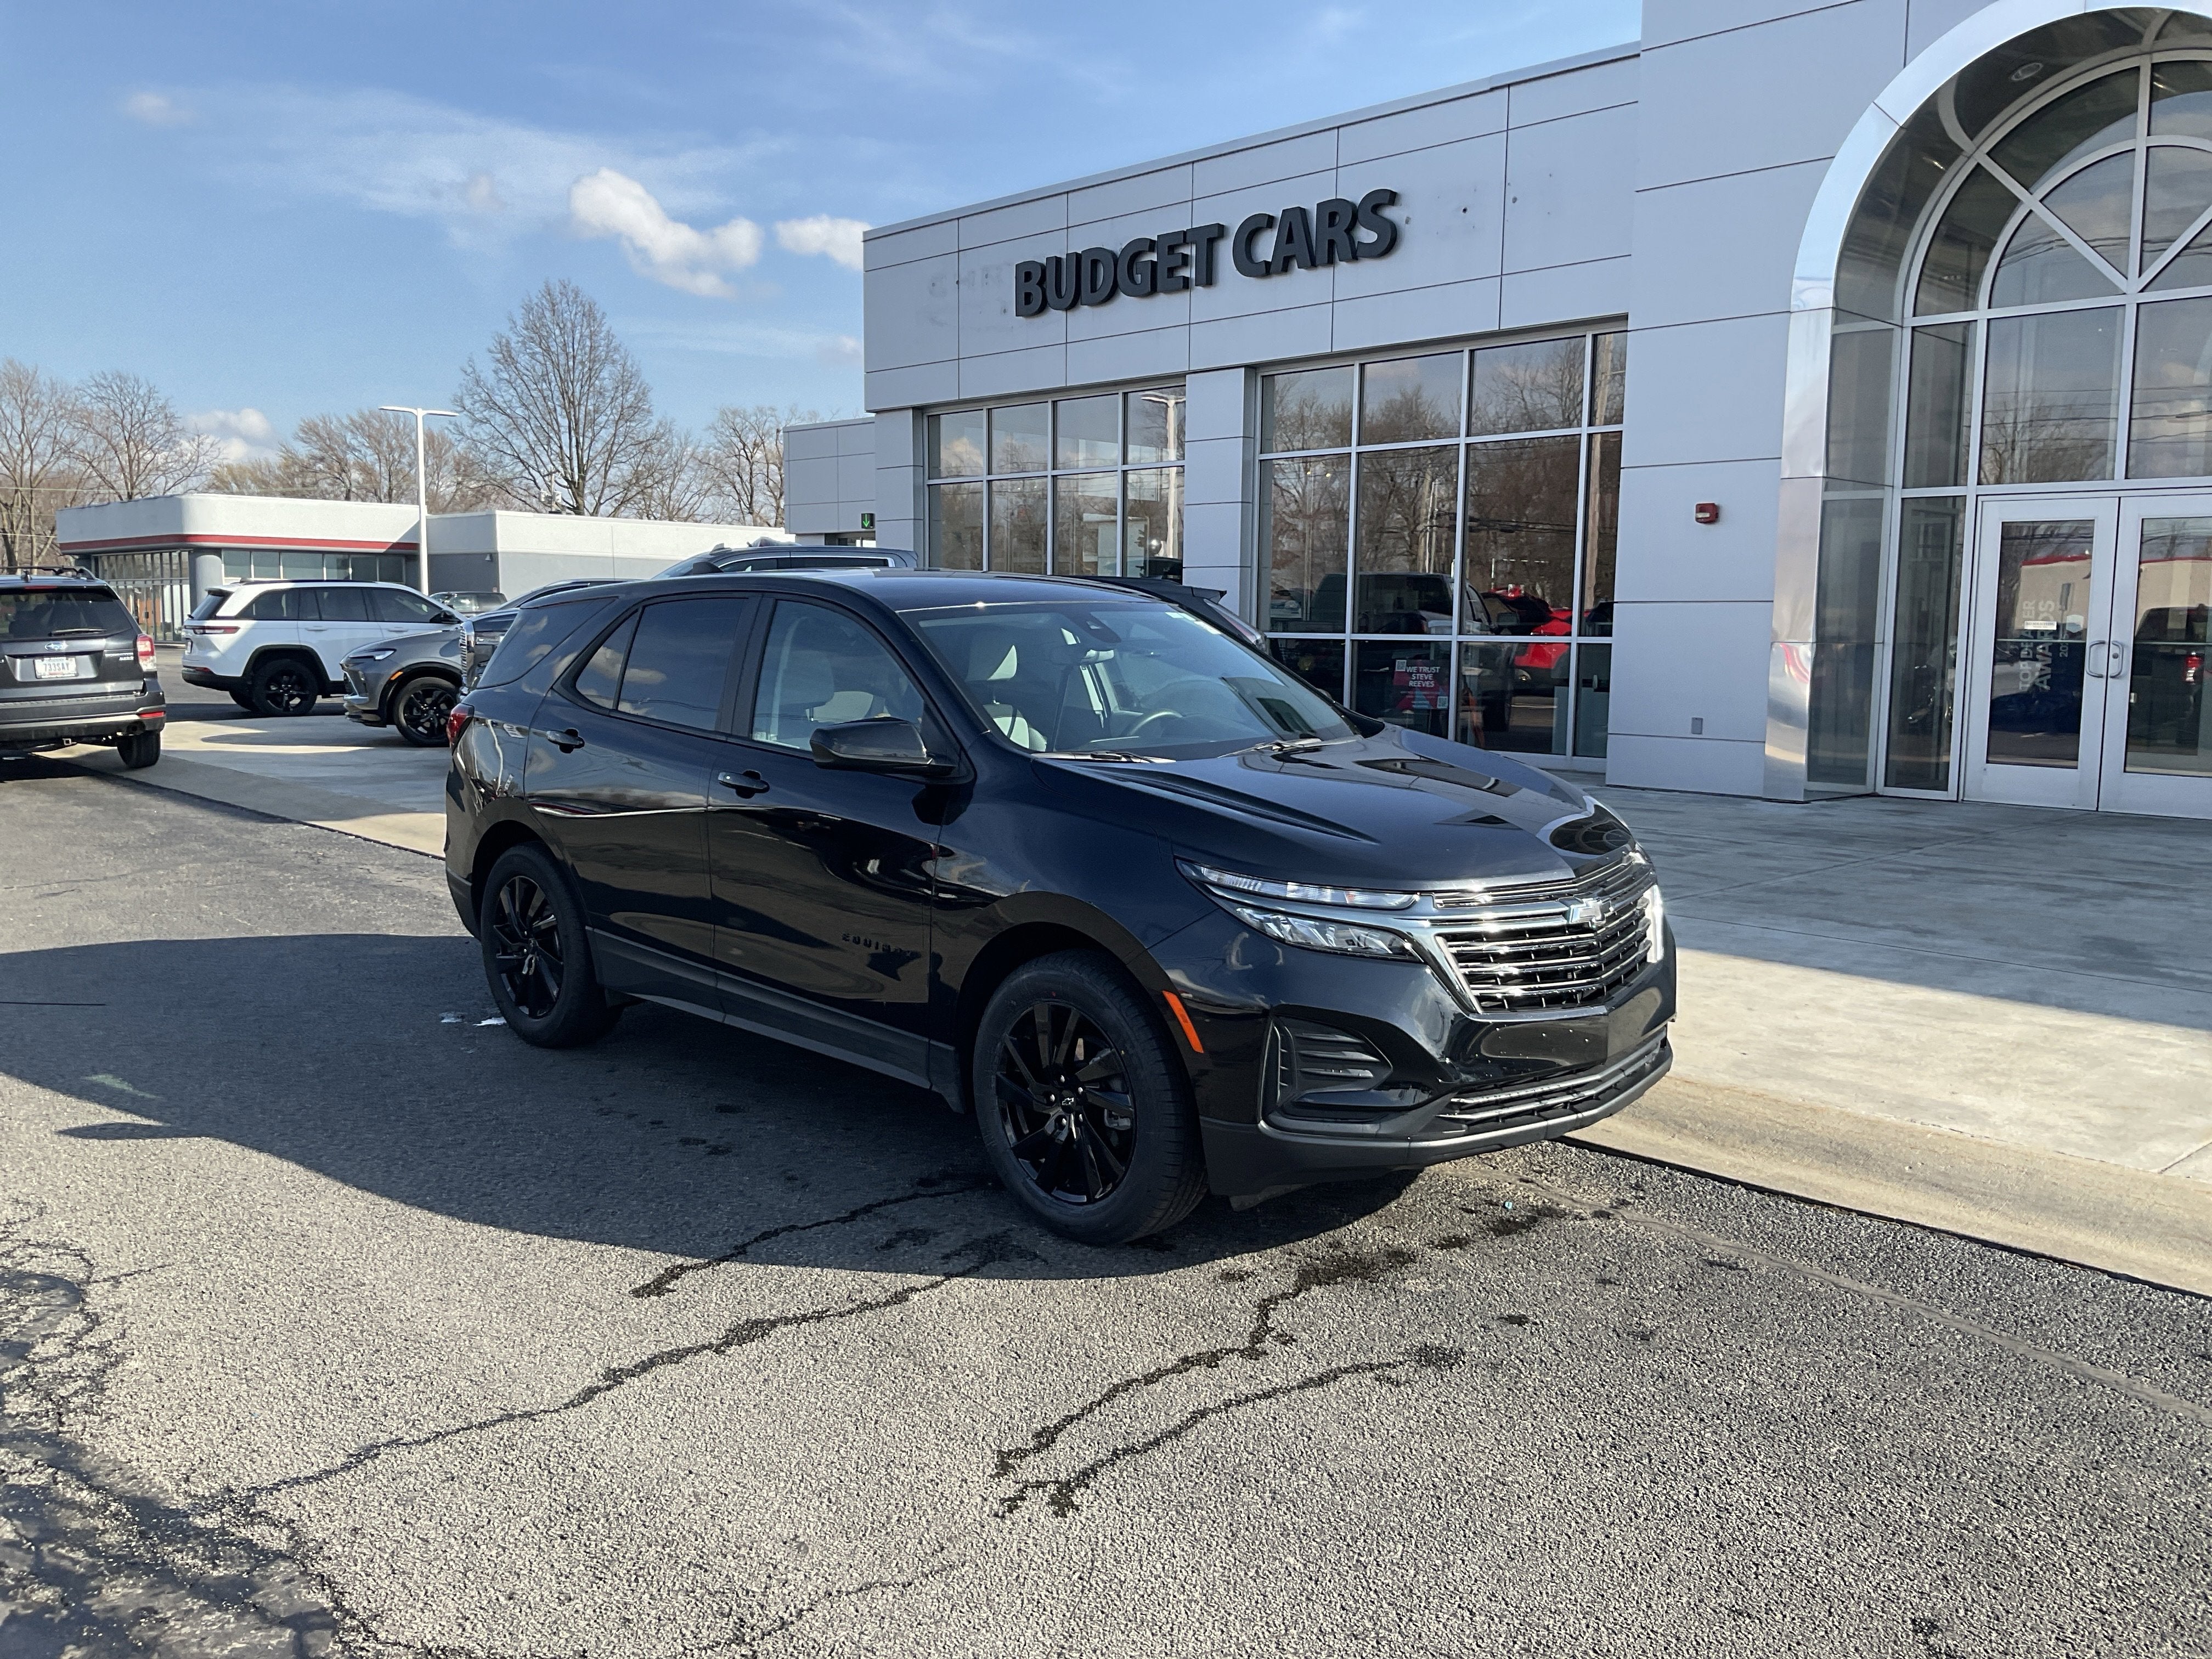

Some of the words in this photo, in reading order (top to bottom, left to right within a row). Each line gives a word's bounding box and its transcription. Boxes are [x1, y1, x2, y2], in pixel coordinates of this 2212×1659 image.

[1015, 223, 1224, 317] BUDGET
[1233, 189, 1398, 278] CARS
[2020, 601, 2035, 658] DEAER
[2019, 661, 2032, 691] TOP
